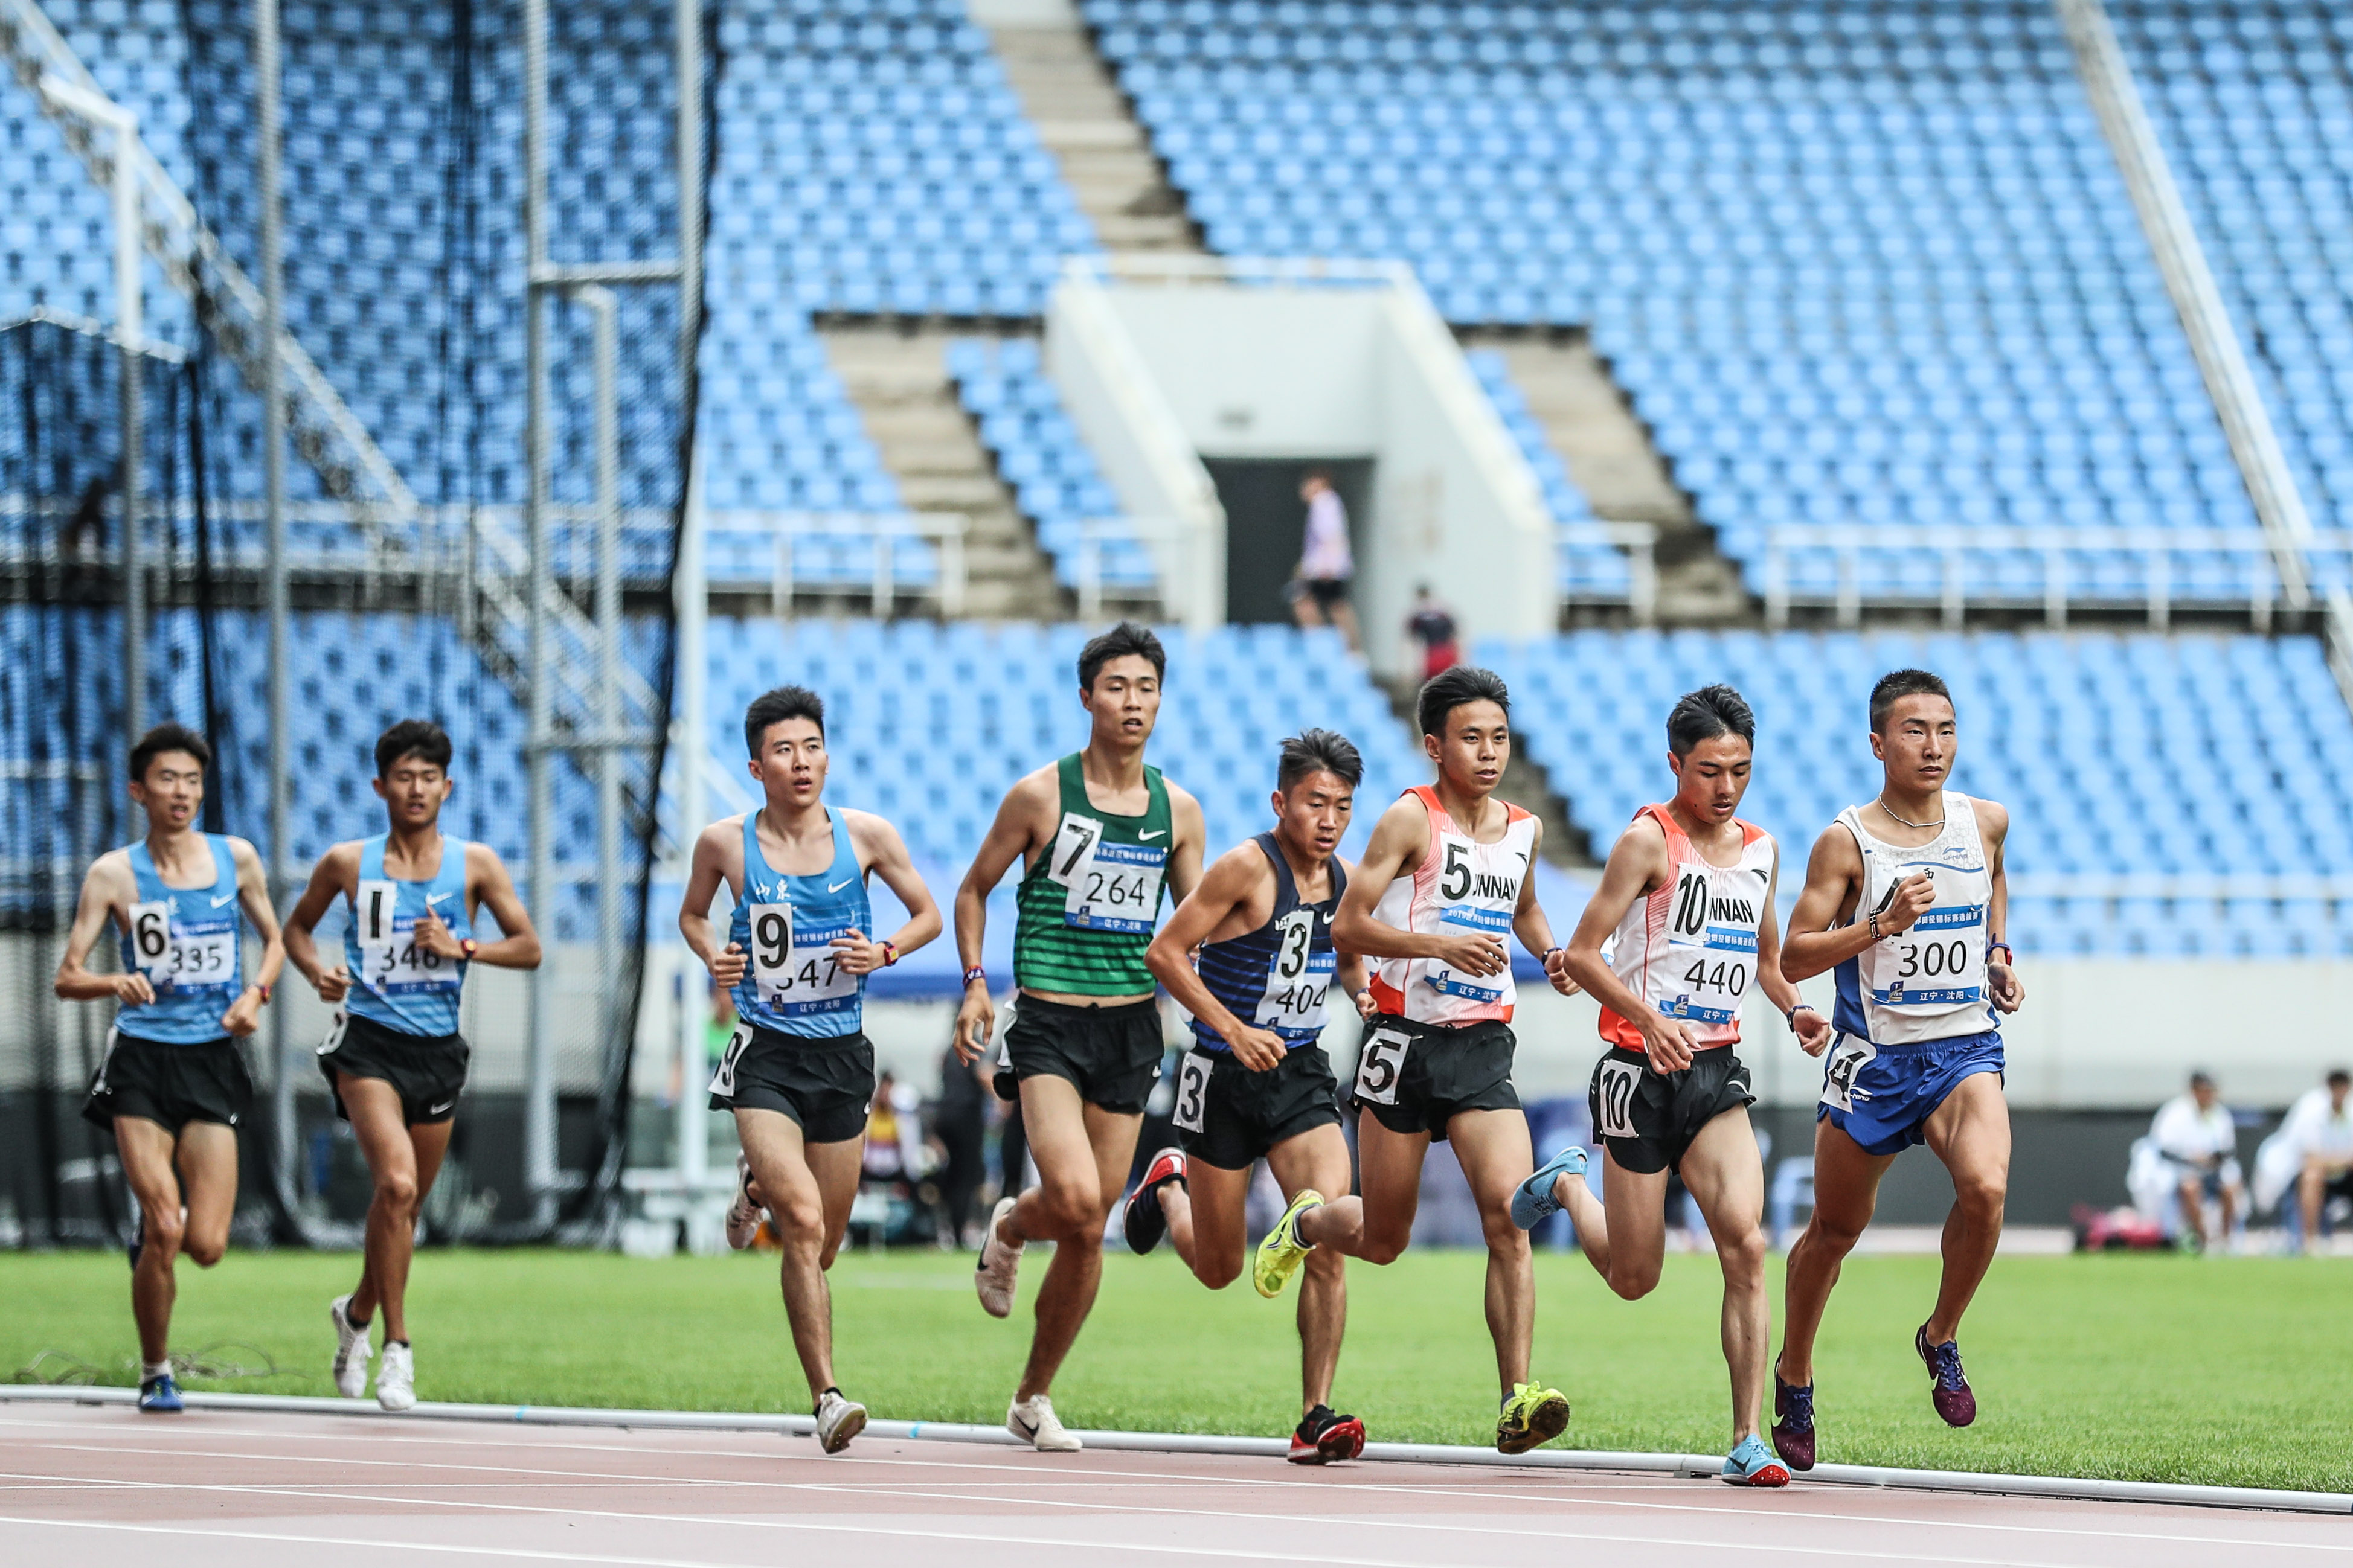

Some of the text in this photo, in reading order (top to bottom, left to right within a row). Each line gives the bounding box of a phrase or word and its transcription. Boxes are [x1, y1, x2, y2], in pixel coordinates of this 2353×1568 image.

[1060, 823, 1094, 877] 7
[1442, 842, 1471, 900] 5
[1085, 872, 1145, 906] 264
[1674, 873, 1707, 935] 10
[138, 913, 165, 956] 6
[370, 891, 382, 939] 1
[167, 943, 222, 974] 335
[380, 941, 440, 972] 346
[757, 913, 789, 969] 9
[1281, 923, 1306, 978] 3
[1898, 940, 1967, 978] 300
[1276, 985, 1327, 1015] 404
[1684, 959, 1745, 996] 440
[1362, 1039, 1402, 1094] 5
[1180, 1066, 1204, 1122] 3
[1603, 1068, 1632, 1131] 10
